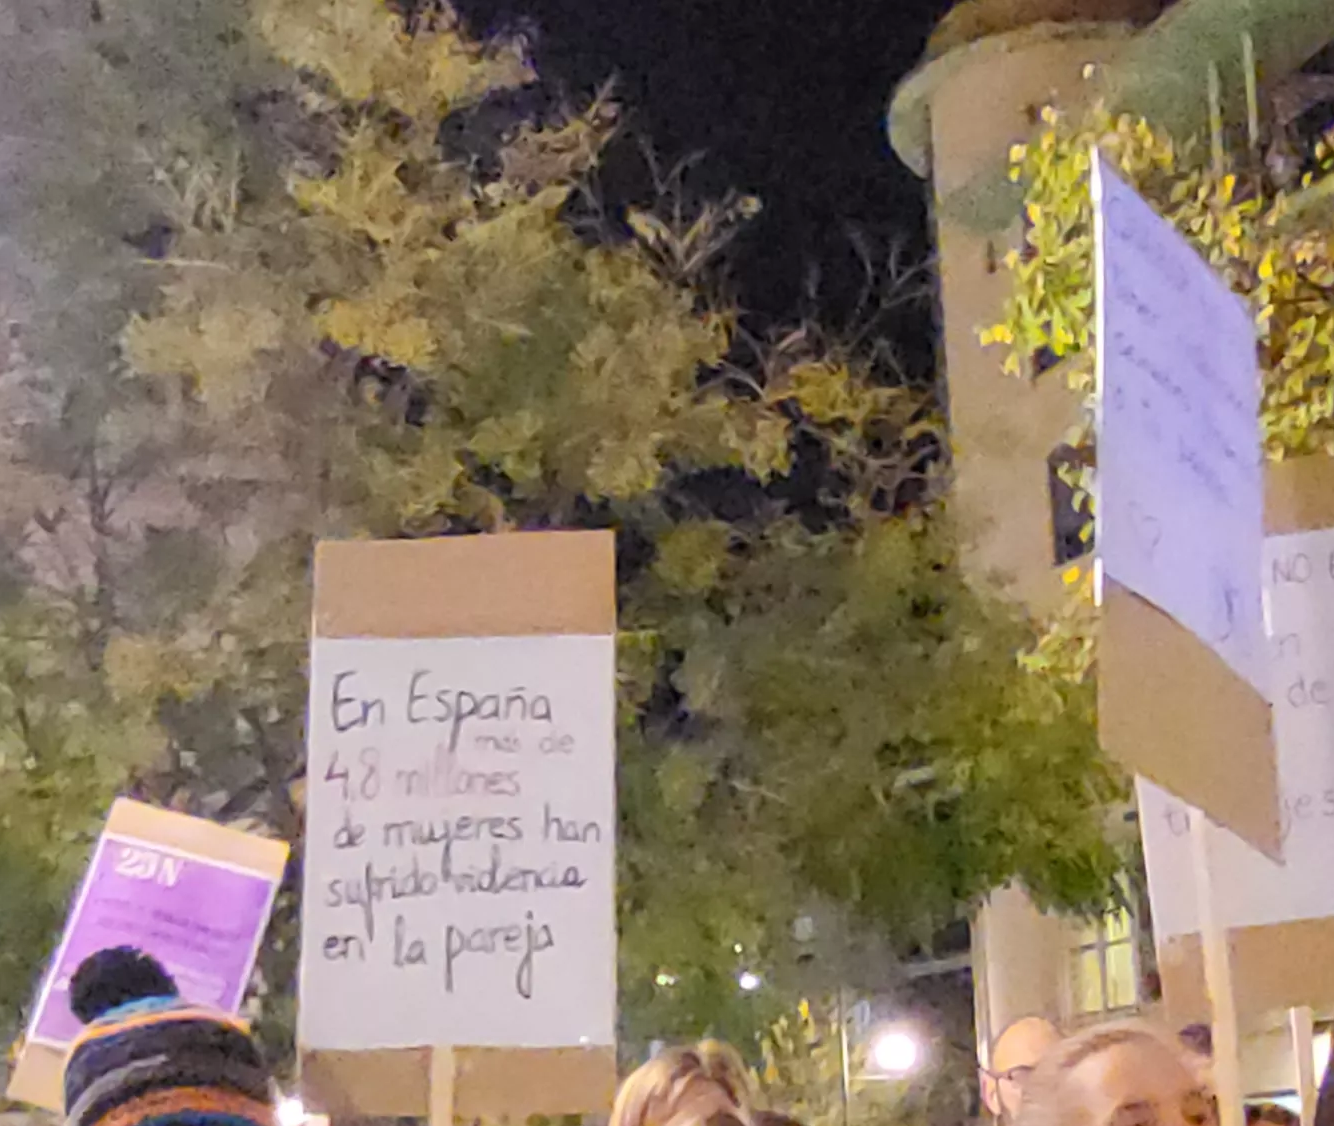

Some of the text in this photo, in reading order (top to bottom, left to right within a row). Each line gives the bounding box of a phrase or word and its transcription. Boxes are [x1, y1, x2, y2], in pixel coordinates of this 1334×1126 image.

[331, 668, 552, 752] En España
[332, 803, 601, 883] de mujeres han
[323, 856, 439, 943] sufrido
[322, 910, 555, 1000] en la pareja
